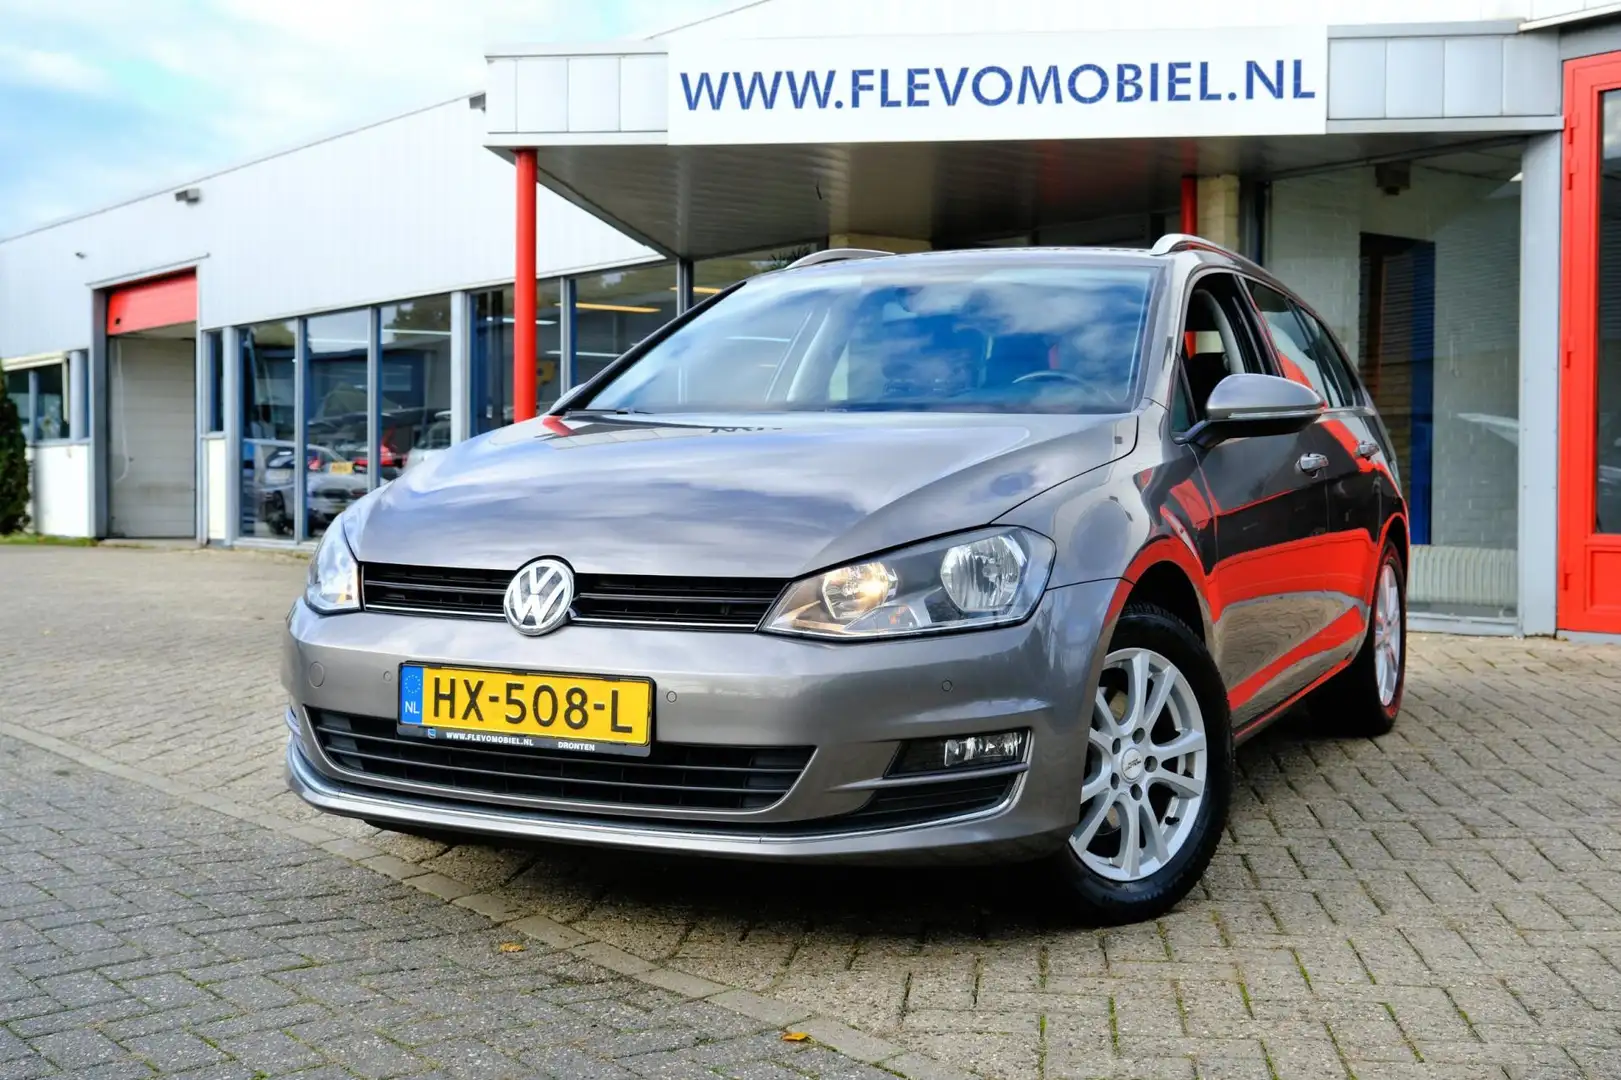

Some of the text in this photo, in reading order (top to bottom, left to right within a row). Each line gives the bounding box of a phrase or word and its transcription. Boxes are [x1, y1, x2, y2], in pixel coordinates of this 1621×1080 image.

[680, 59, 1315, 110] WWW.FLEVOMOBIEL.NL
[404, 700, 420, 715] NL
[433, 676, 633, 734] HX-508-L
[445, 731, 596, 751] WWW.FLEVOMOBIEL.NL DRONTEN
